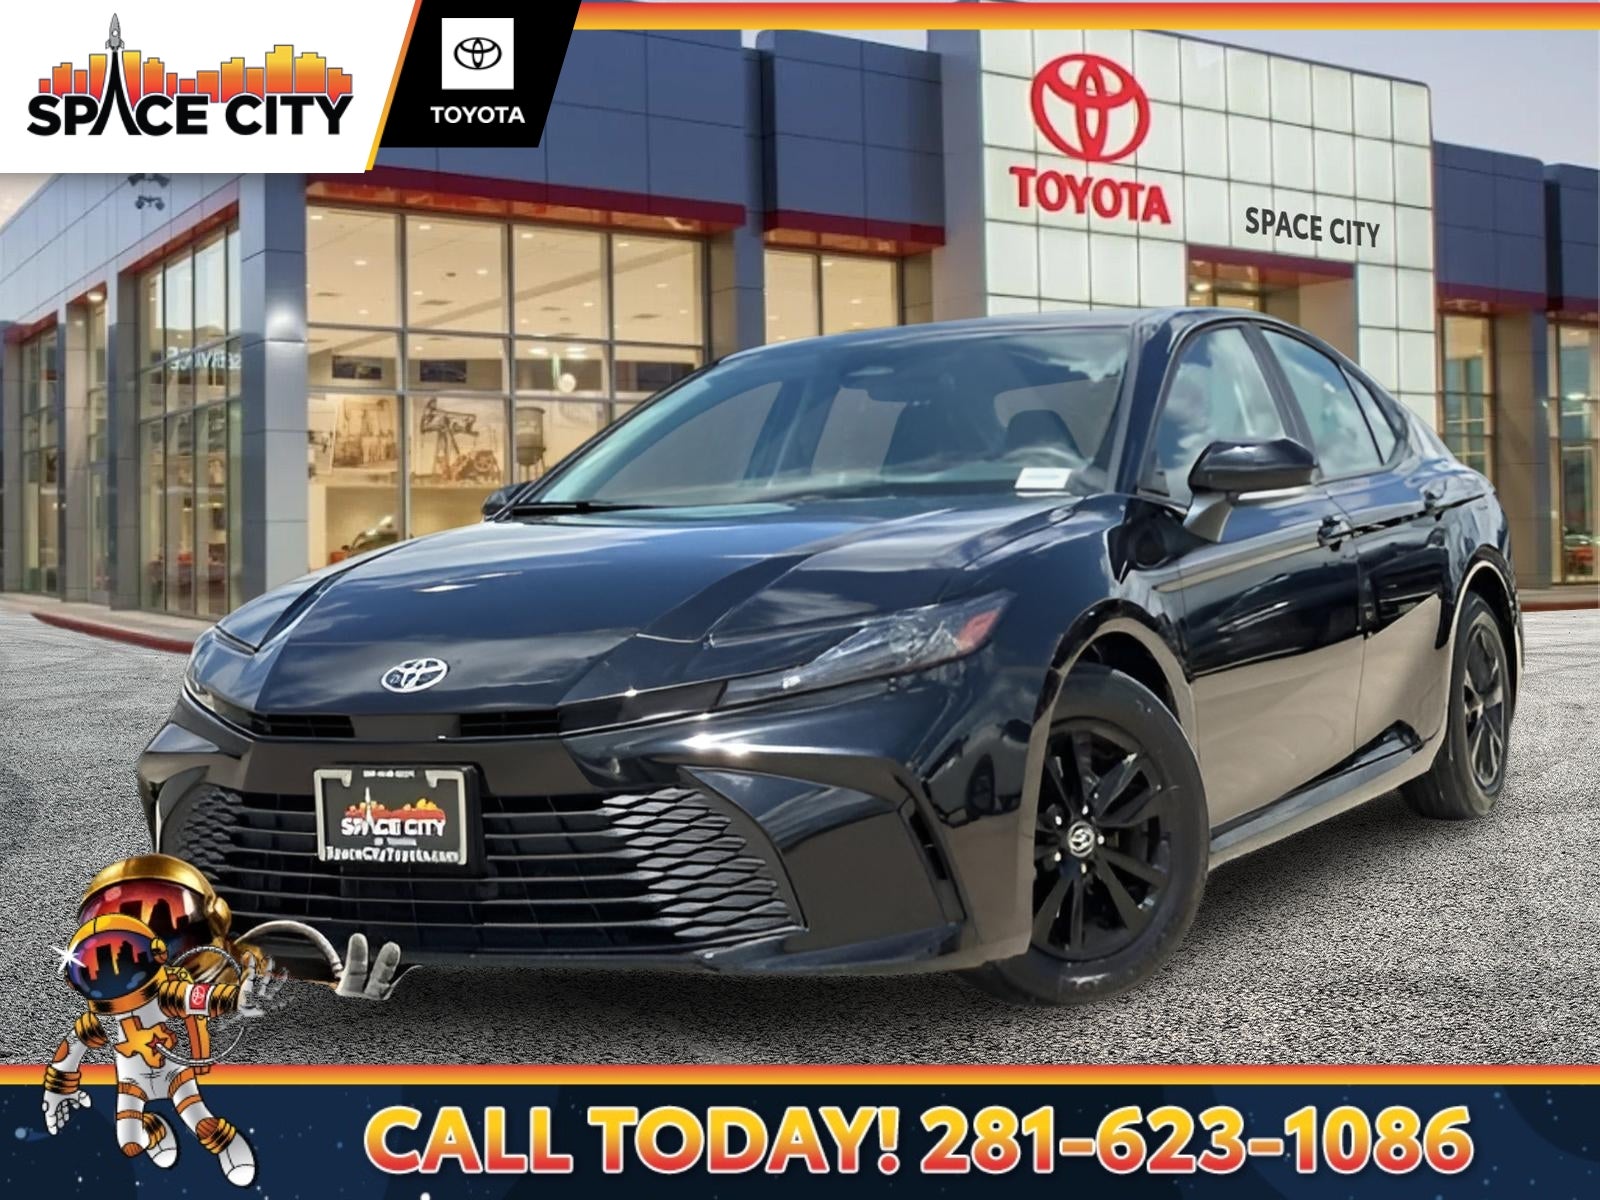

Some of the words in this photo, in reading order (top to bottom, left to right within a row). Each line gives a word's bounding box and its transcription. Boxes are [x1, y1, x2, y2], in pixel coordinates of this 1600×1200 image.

[1009, 166, 1171, 224] TOYOTA
[1245, 206, 1323, 242] SPACE
[1329, 218, 1381, 248] CITY
[404, 818, 446, 836] CITY
